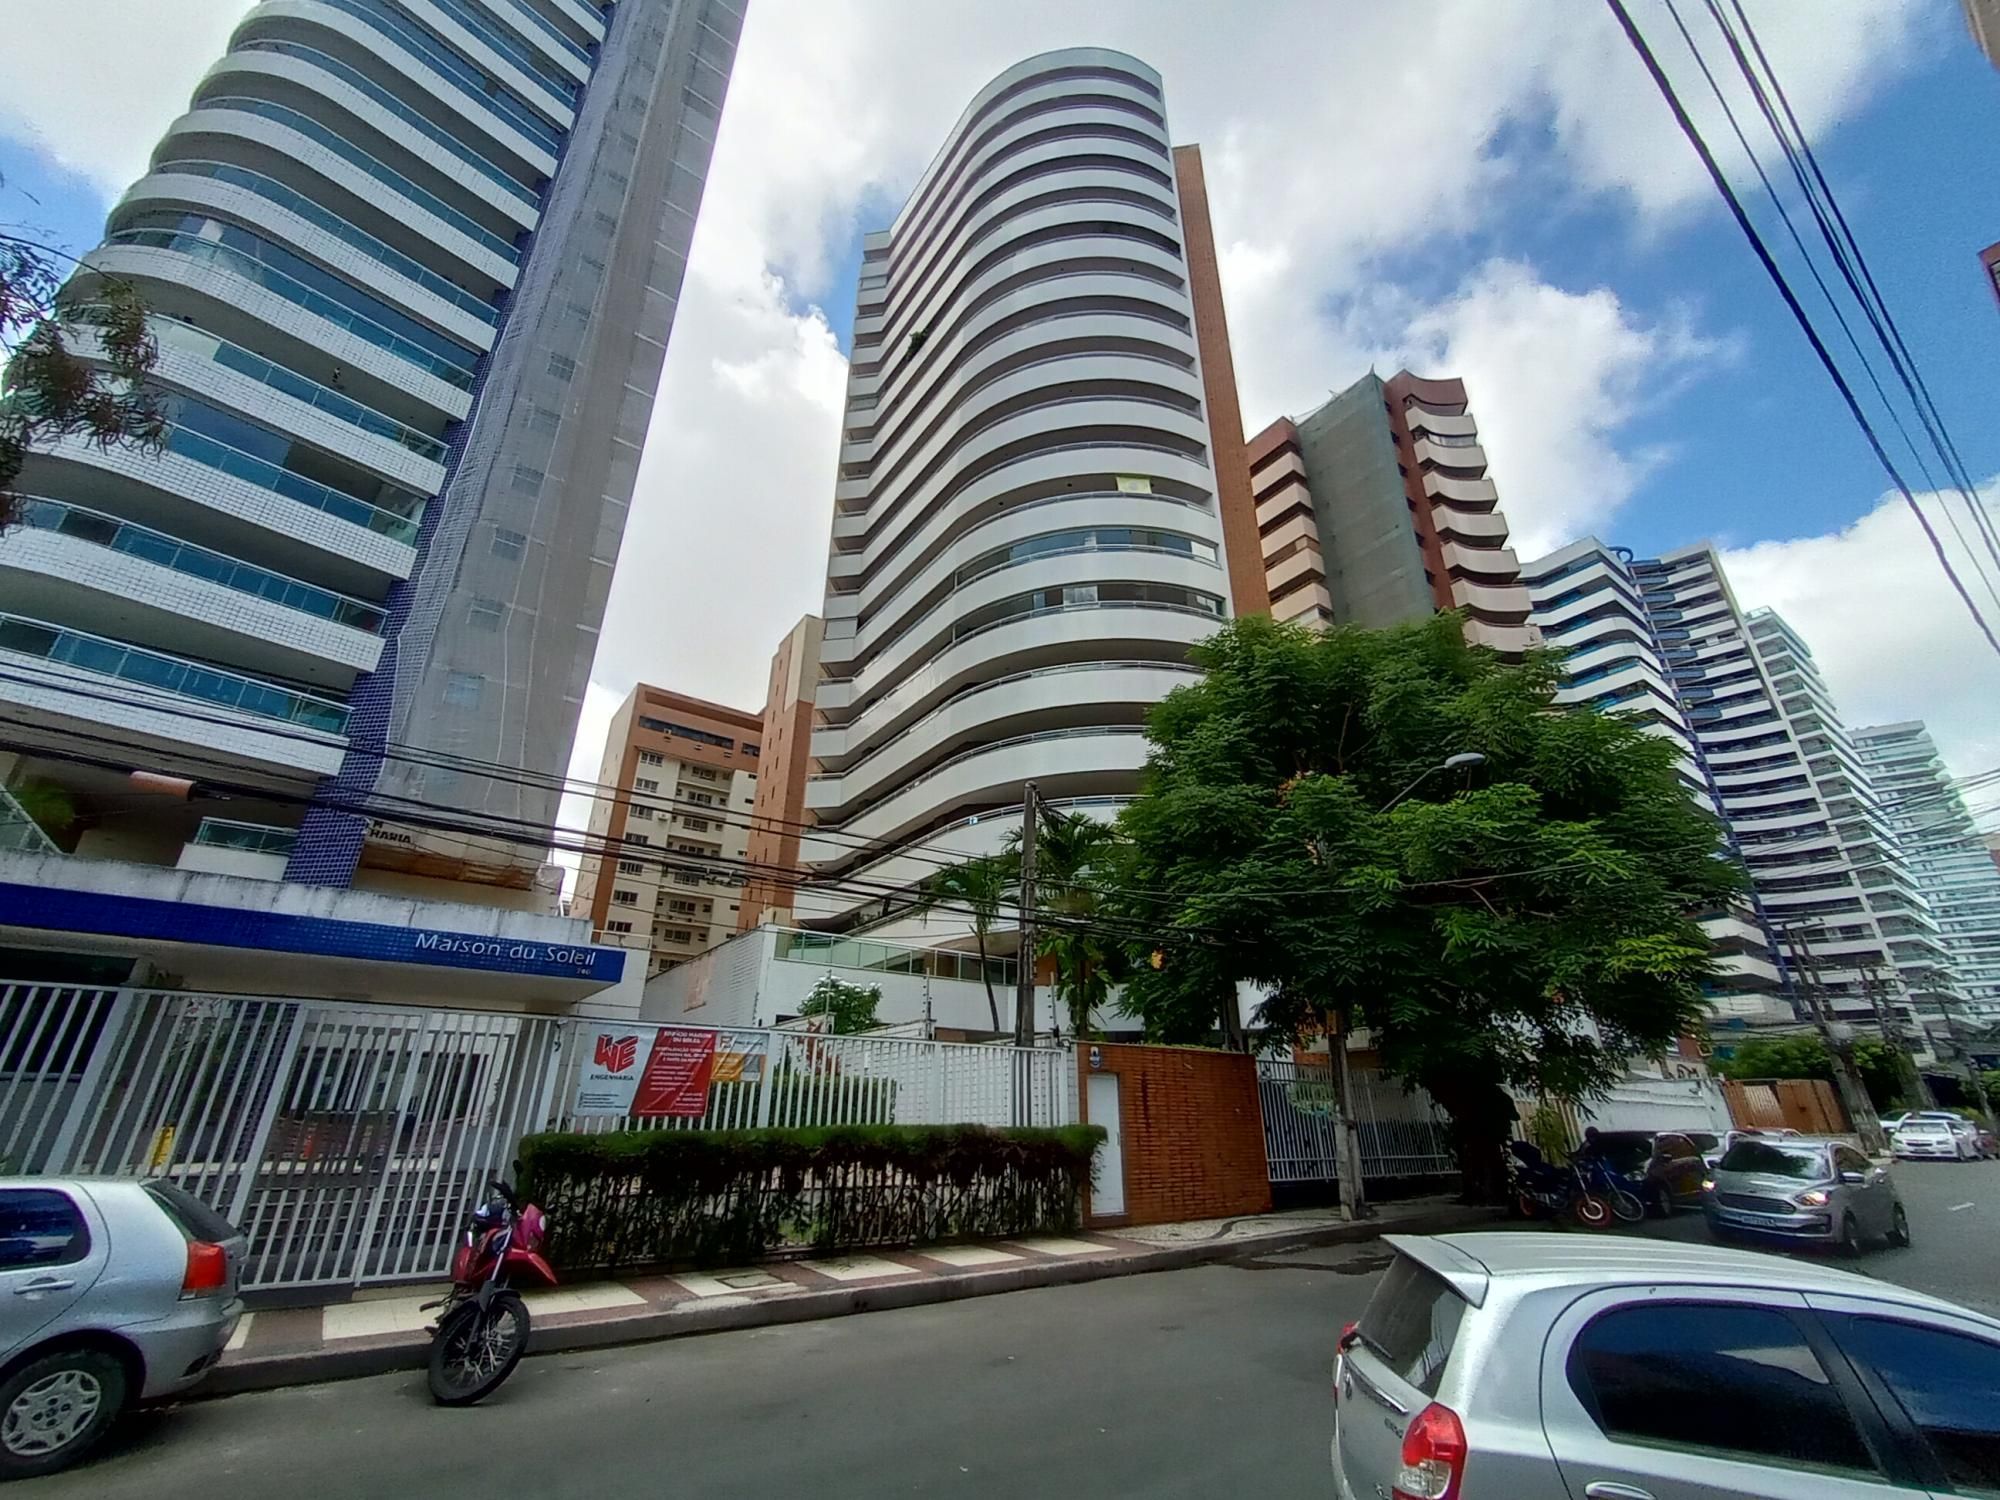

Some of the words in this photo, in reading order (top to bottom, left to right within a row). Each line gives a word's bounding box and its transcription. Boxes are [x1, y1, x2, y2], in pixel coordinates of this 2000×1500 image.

[415, 933, 501, 956] Maison
[509, 944, 536, 960] du
[545, 946, 596, 966] Soleil
[594, 1034, 639, 1074] WE
